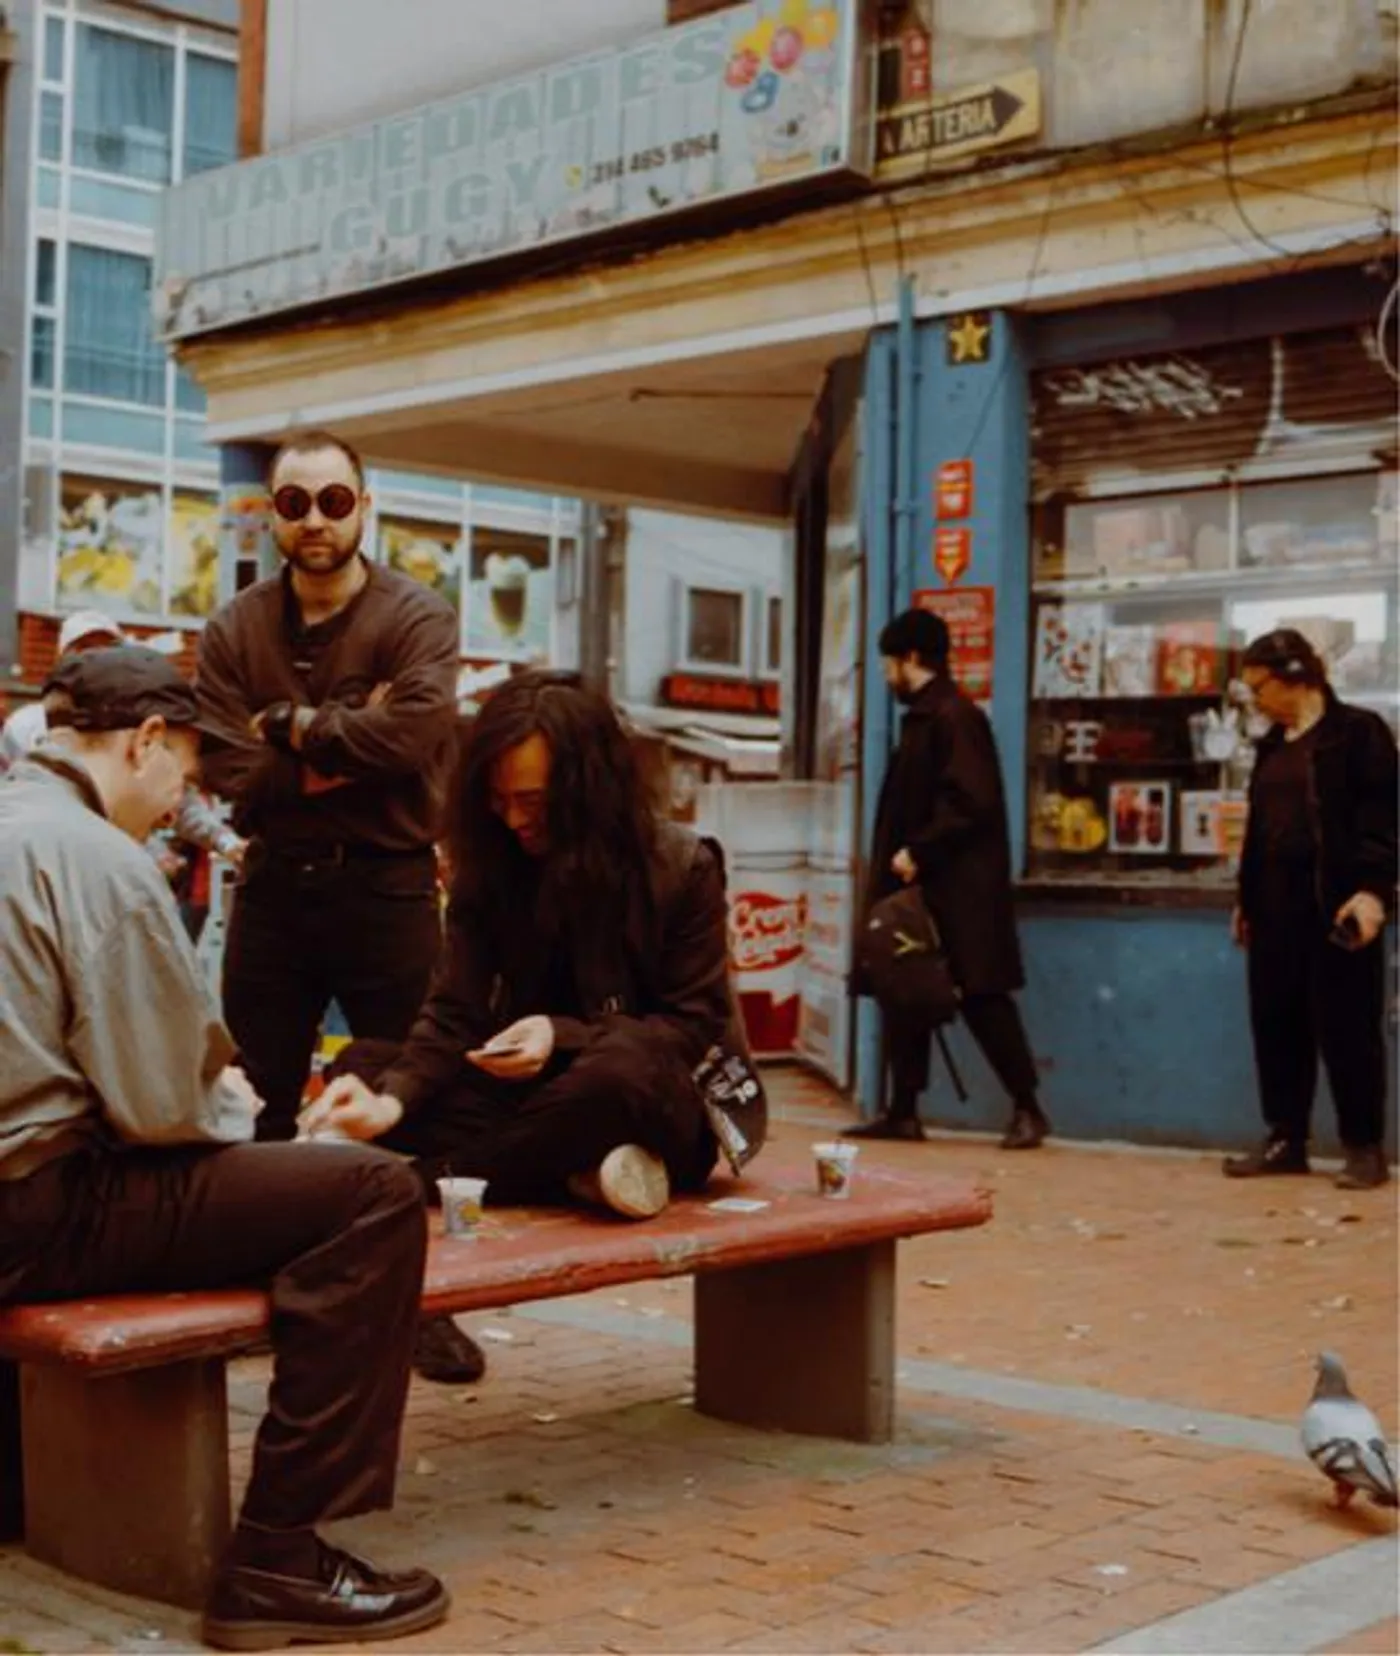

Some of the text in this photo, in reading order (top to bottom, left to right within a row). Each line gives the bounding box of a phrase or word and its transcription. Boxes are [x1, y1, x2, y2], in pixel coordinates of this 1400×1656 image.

[206, 27, 726, 218] VARIEDADES
[899, 97, 996, 152] ARTERIA
[329, 158, 551, 251] GUGY
